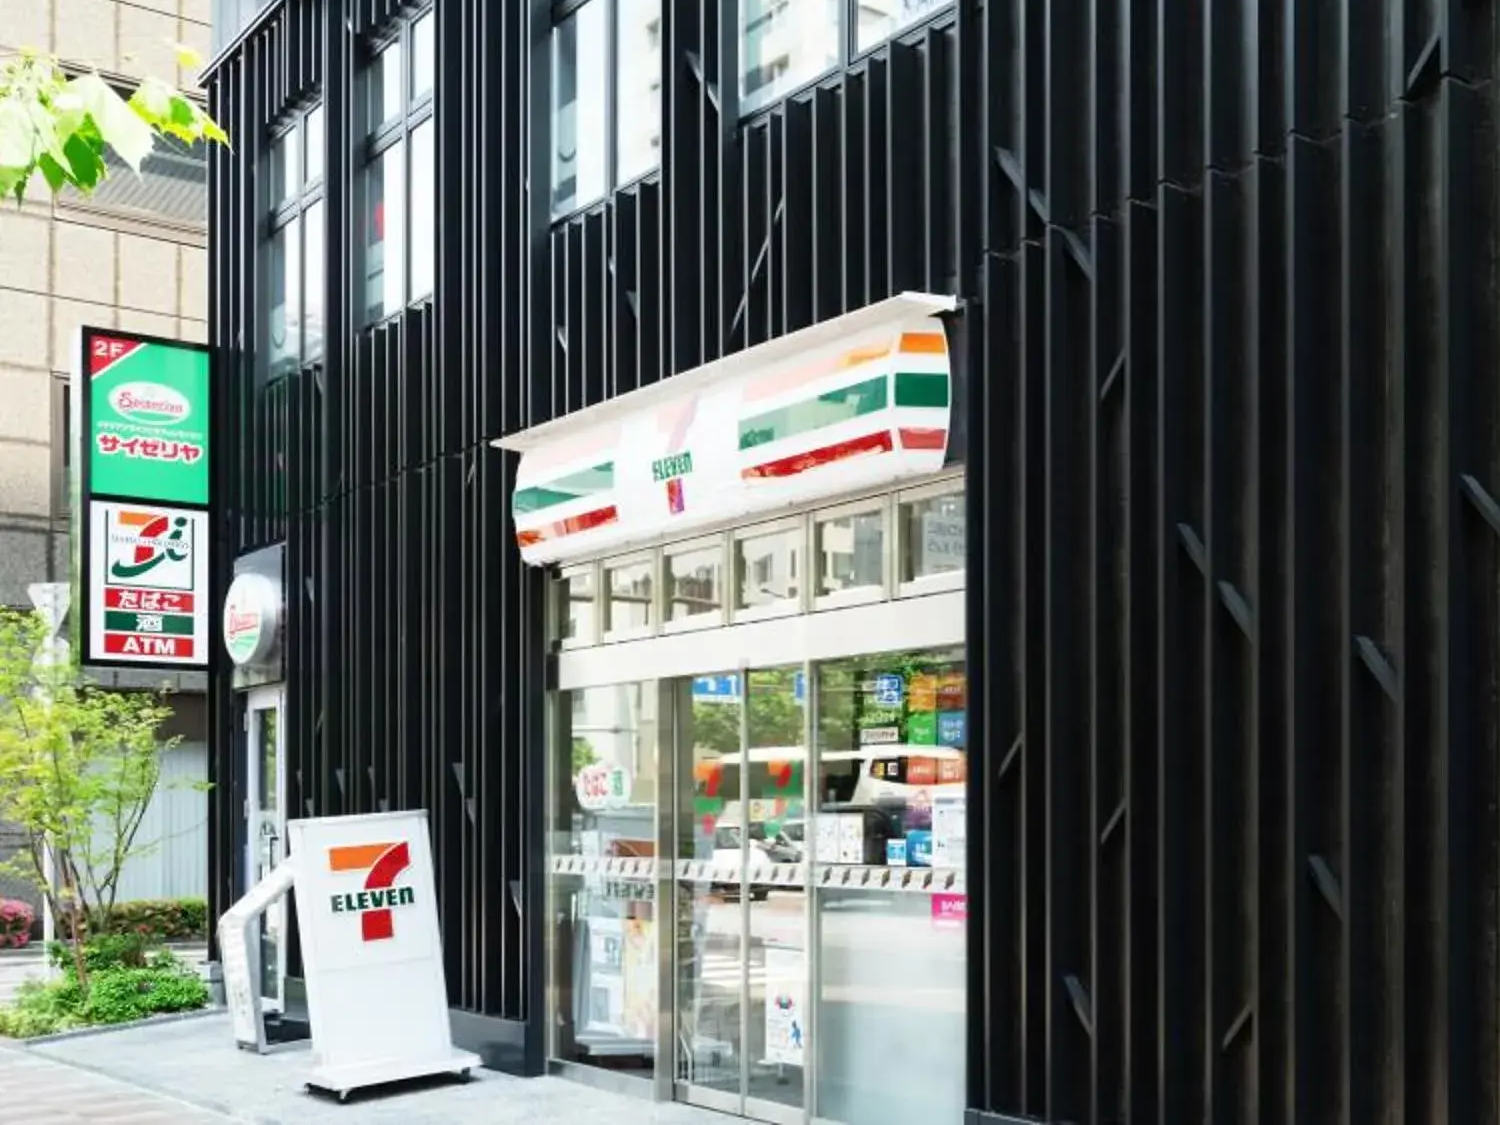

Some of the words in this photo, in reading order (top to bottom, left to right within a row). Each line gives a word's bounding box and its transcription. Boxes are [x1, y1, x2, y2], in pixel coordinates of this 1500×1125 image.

[95, 340, 124, 358] 2F
[98, 433, 202, 463] サイゼリヤ
[119, 590, 182, 612] たばこ
[122, 636, 176, 655] ATM
